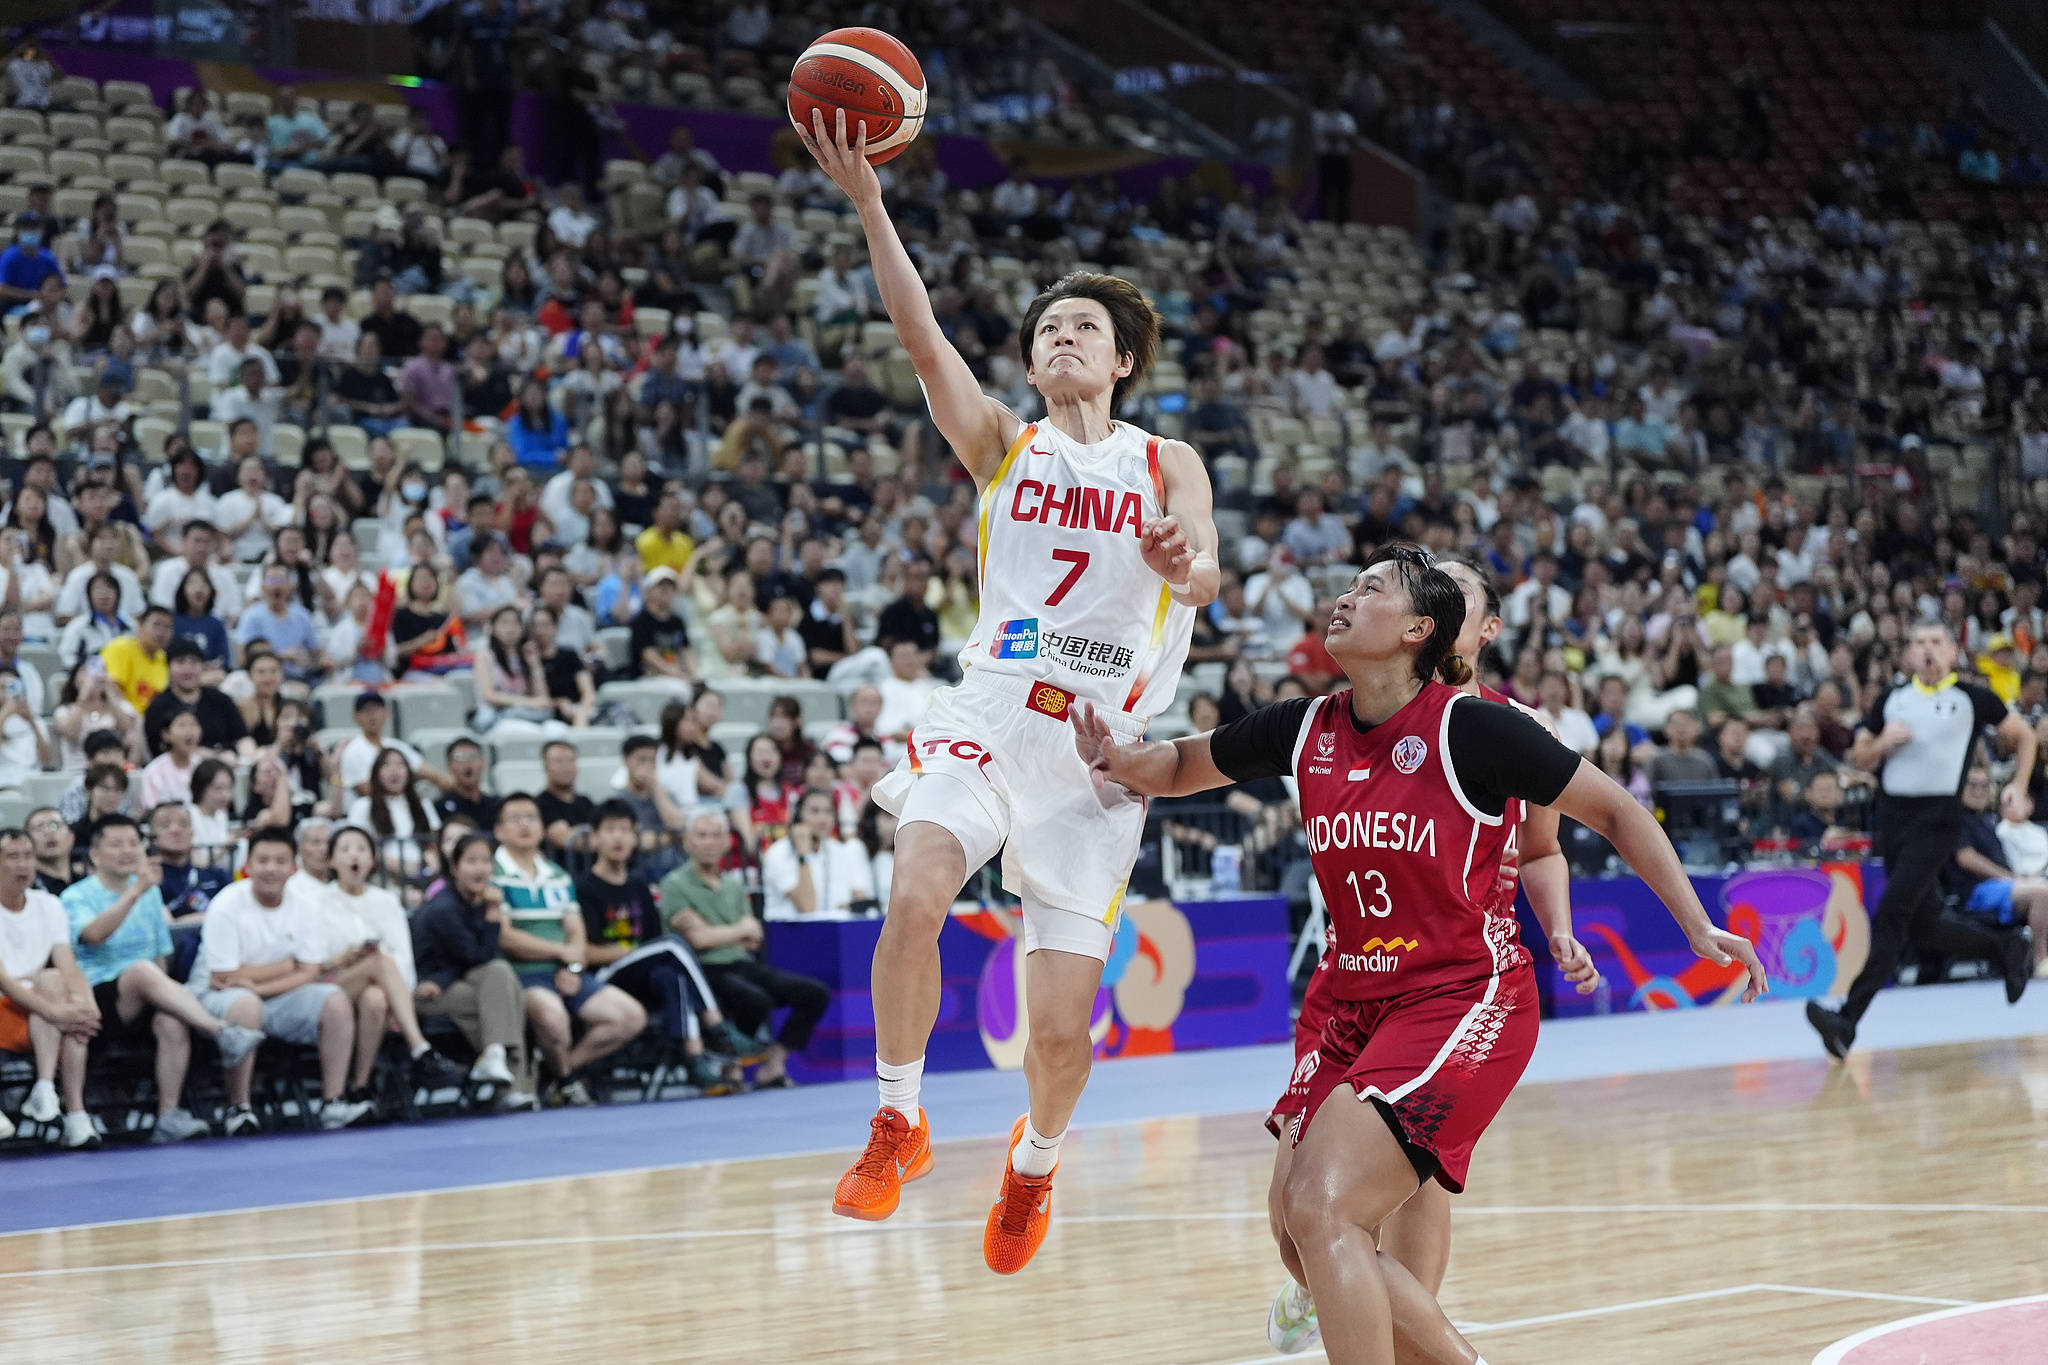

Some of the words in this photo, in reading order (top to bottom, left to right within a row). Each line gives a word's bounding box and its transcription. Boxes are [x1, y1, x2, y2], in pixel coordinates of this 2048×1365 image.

[809, 70, 865, 96] molten
[1010, 479, 1142, 539] CHINA
[1044, 548, 1090, 607] 7
[995, 628, 1038, 643] UnionPay
[1010, 641, 1036, 652] 银联
[1042, 631, 1134, 669] 中国银联
[1039, 646, 1067, 667] China
[1304, 811, 1436, 857] NDONESIA
[1345, 869, 1393, 918] 13
[1338, 949, 1399, 972] mandiri
